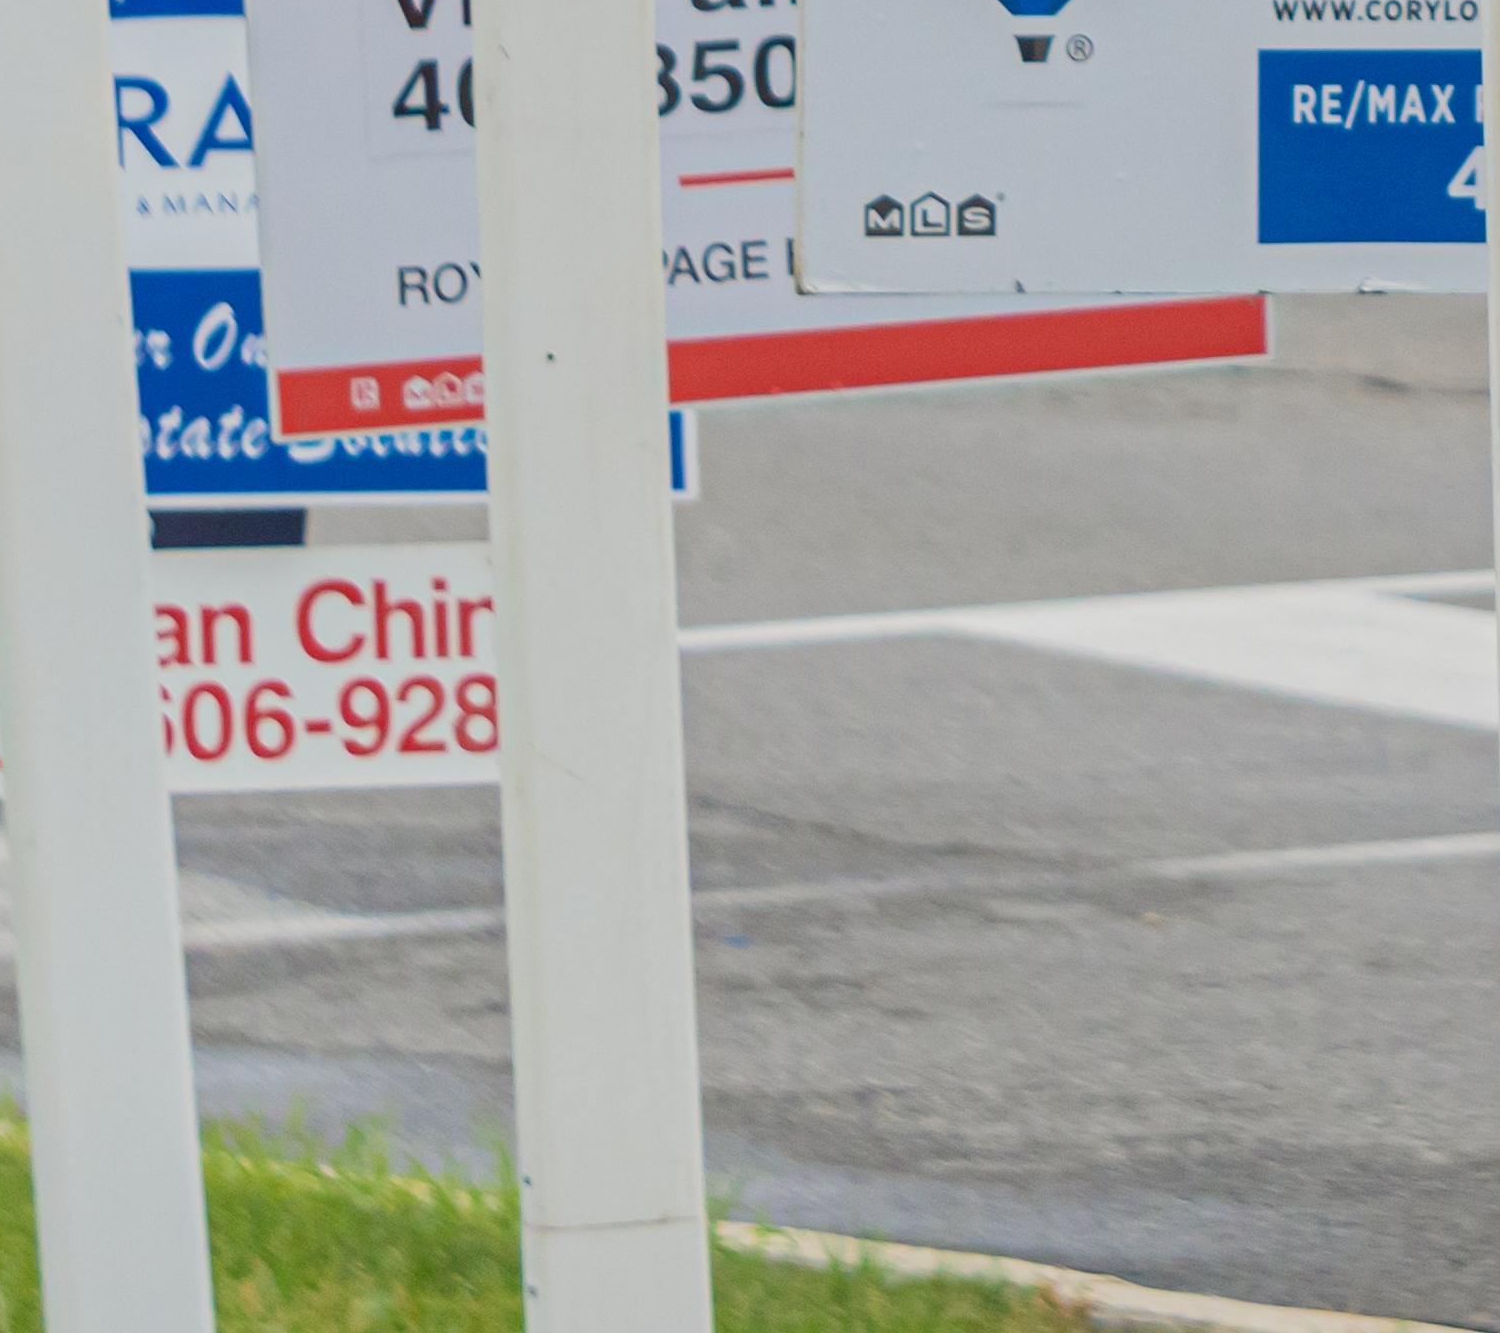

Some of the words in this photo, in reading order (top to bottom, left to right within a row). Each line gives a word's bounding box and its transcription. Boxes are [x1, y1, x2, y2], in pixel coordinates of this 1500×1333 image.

[1273, 0, 1478, 23] WWW.CORYLO
[1292, 80, 1457, 129] RE/MAX
[296, 577, 495, 667] Chin
